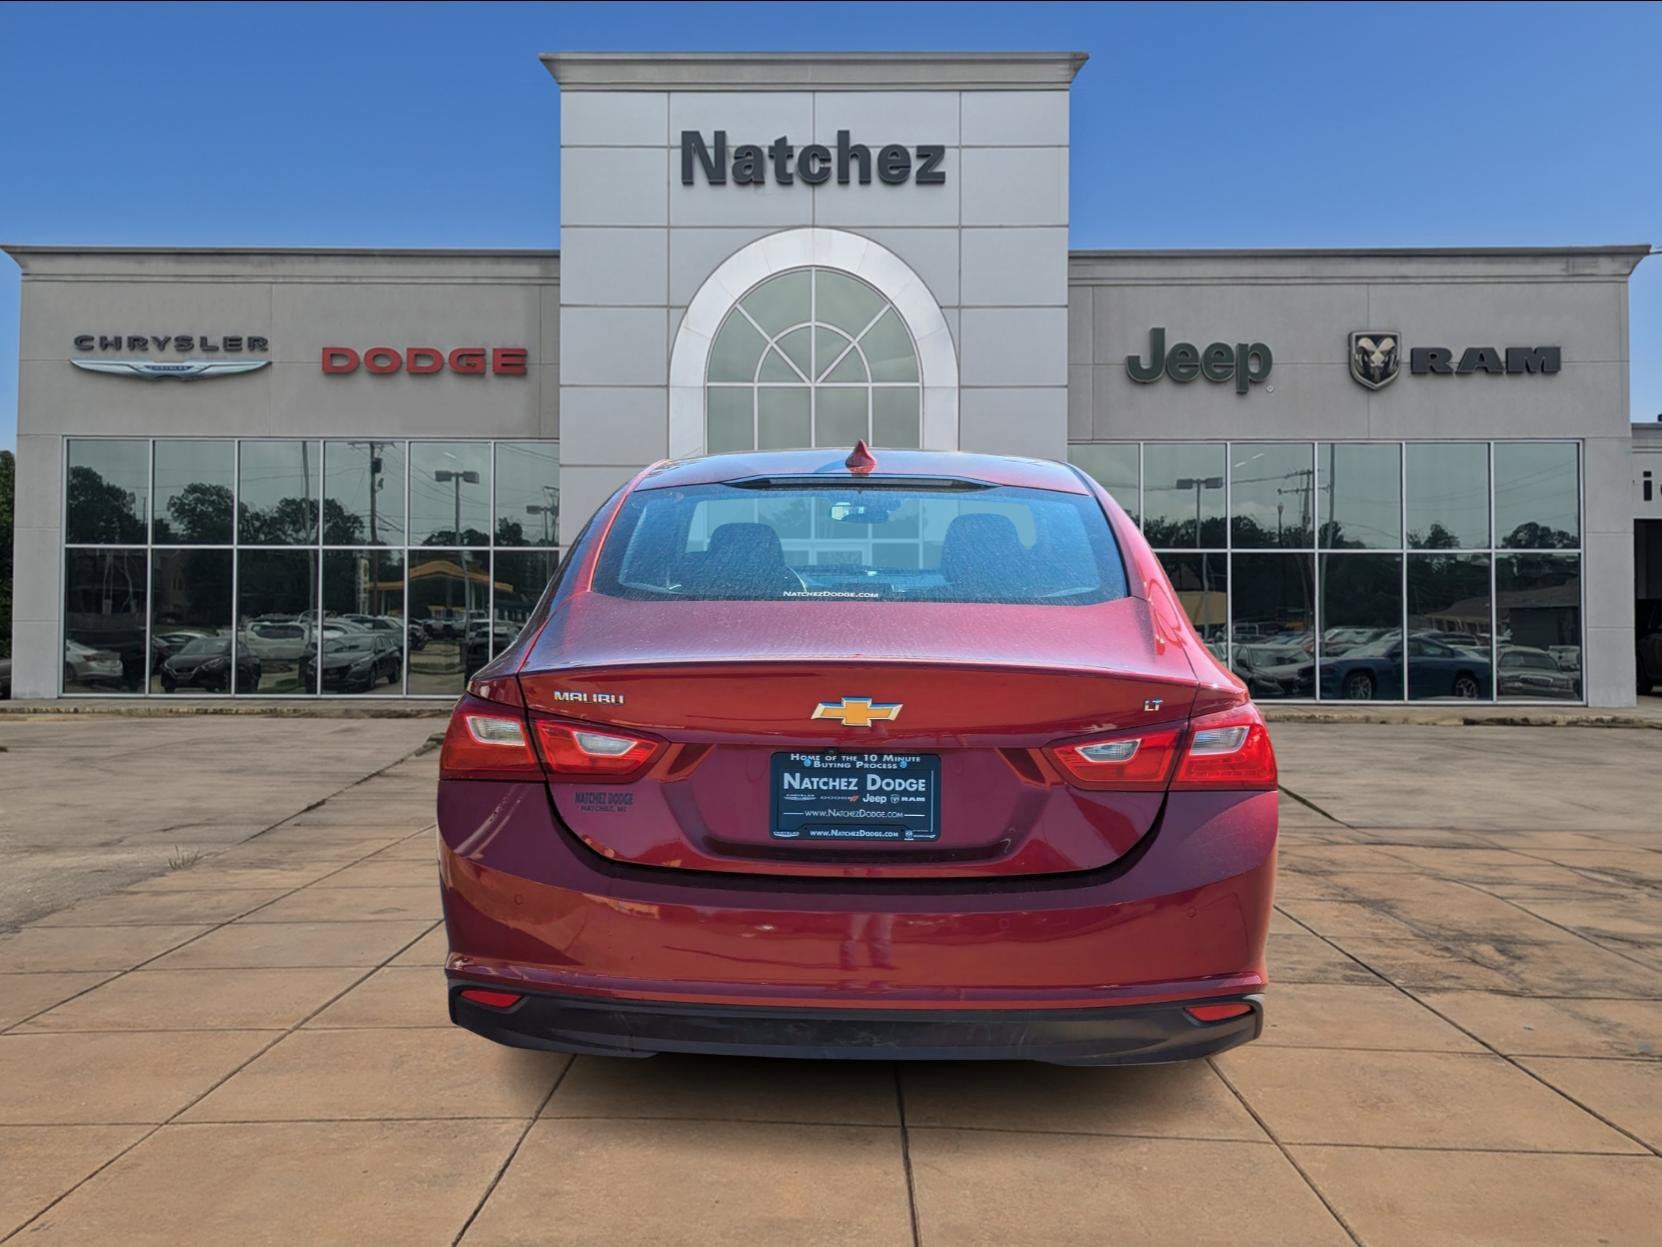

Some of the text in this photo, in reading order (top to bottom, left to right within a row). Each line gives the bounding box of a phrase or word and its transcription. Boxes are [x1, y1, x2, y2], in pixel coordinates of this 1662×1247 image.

[681, 130, 946, 186] Natchez
[73, 334, 270, 352] CHRYSLER
[321, 346, 528, 376] DODGE
[1126, 327, 1273, 395] Jeep
[1410, 346, 1562, 376] RAM
[553, 690, 625, 704] MALIBU
[1144, 699, 1164, 712] LT
[863, 754, 878, 762] 10
[862, 793, 887, 804] Jeep
